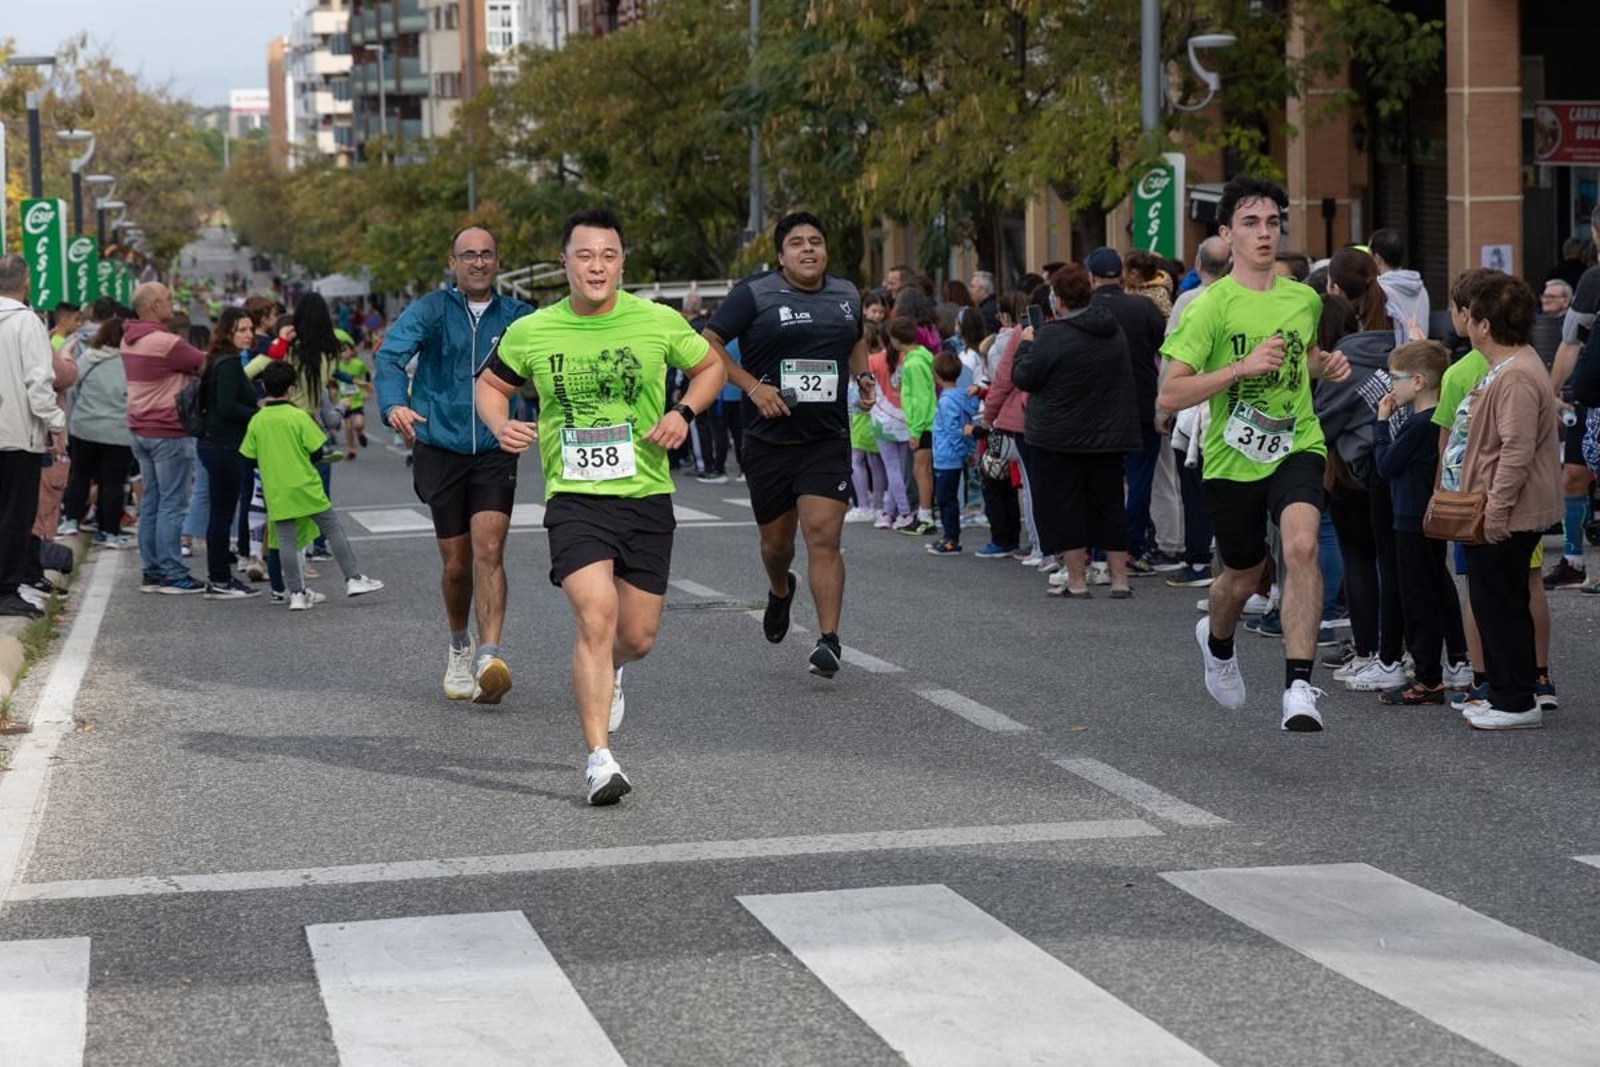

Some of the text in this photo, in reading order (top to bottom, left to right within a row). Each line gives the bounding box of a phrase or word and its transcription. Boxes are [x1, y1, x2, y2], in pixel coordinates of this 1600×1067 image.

[1147, 201, 1162, 253] CSI
[36, 236, 50, 307] CSIF
[1231, 334, 1246, 355] 17
[548, 353, 565, 373] 17
[799, 375, 822, 391] 32
[1237, 426, 1281, 454] 318
[576, 446, 620, 468] 358
